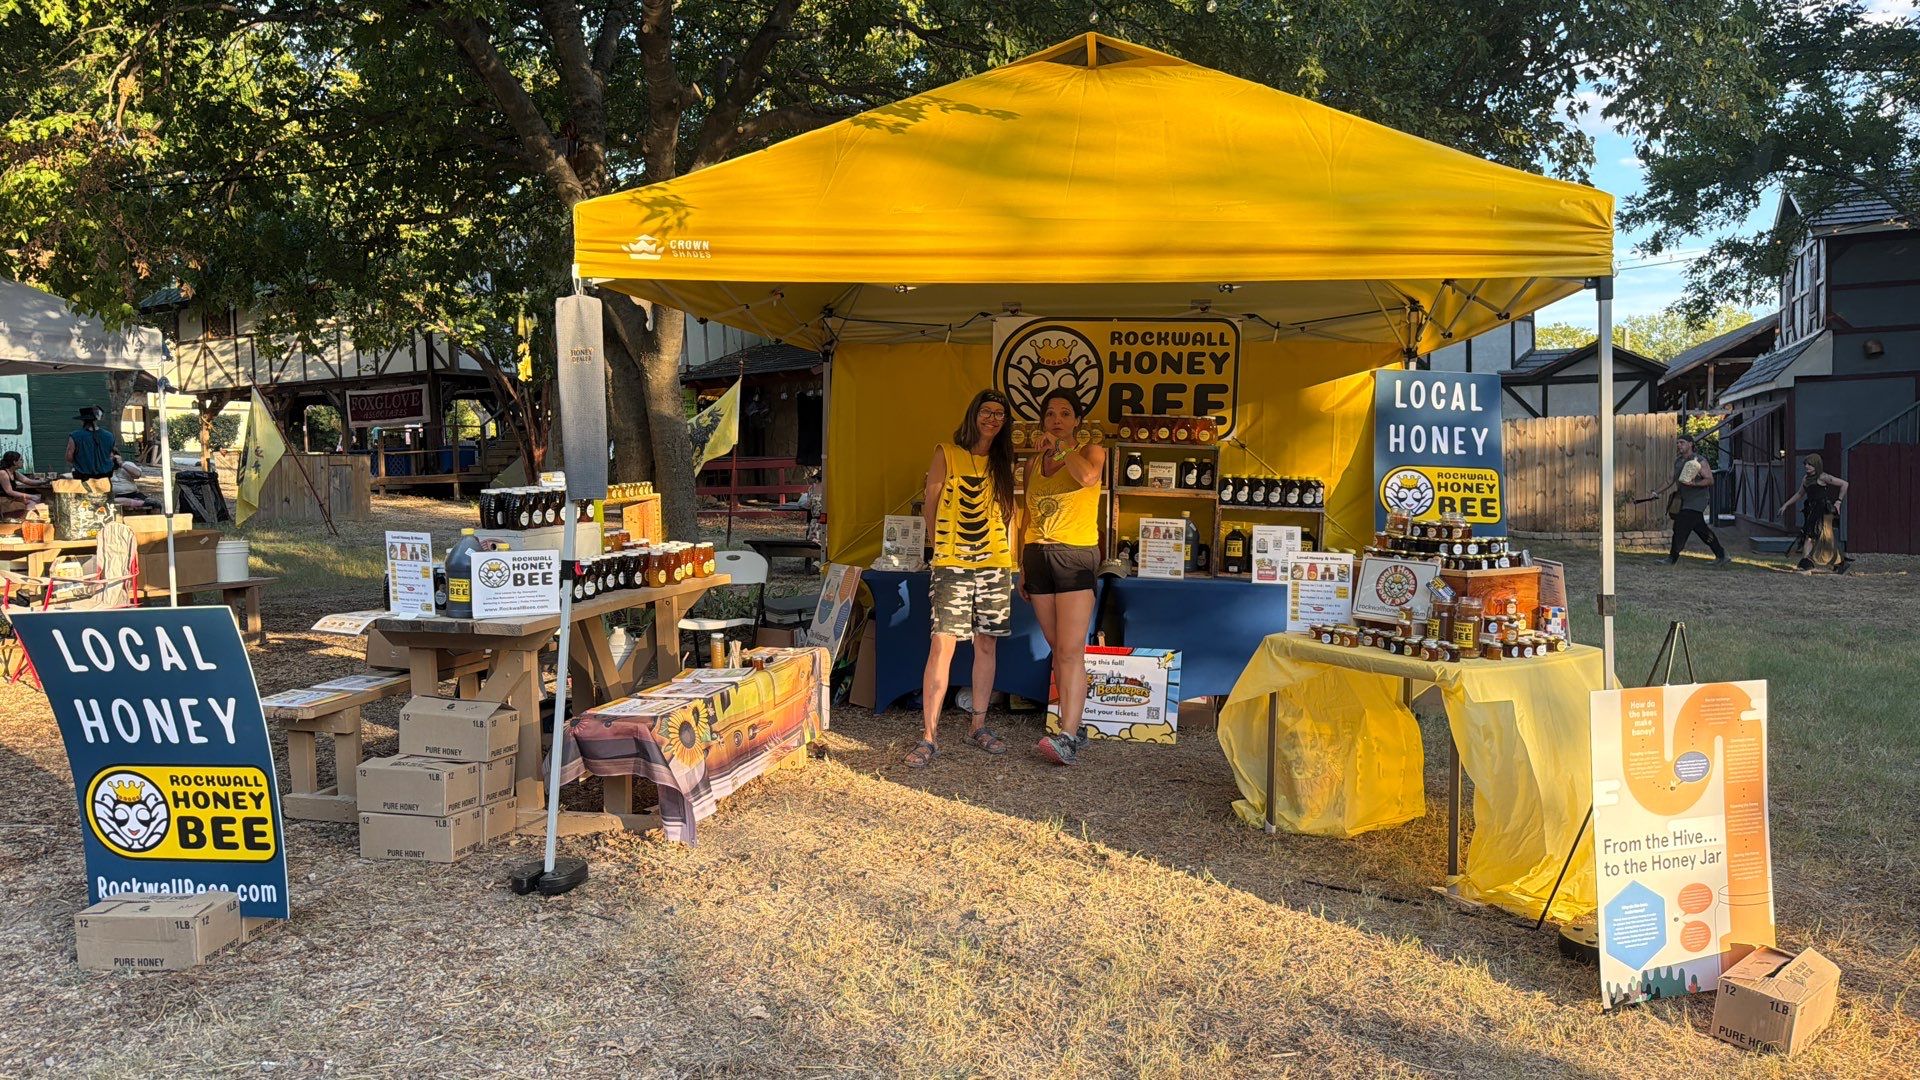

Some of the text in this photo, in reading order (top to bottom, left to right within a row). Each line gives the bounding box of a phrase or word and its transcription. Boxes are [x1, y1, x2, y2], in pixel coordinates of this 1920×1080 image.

[670, 240, 710, 250] CROWN
[672, 250, 712, 259] SHADES
[1110, 331, 1230, 346] ROCKWALL
[571, 348, 593, 356] HONEY
[1109, 351, 1230, 374] HONEY
[351, 392, 420, 411] FOXGLOVE
[1395, 380, 1483, 412] LOCAL
[1389, 424, 1488, 456] HONEY
[1437, 472, 1496, 482] ROCKWALL
[1437, 482, 1496, 494] HONEY
[1438, 496, 1498, 518] BEE
[512, 562, 552, 570] HONEY
[512, 572, 553, 586] BEE
[1376, 566, 1395, 604] Rockwall
[1397, 566, 1416, 591] Honey
[52, 626, 217, 672] LOCAL
[1096, 684, 1150, 698] Beekeepers
[1100, 694, 1142, 703] Conference
[1630, 701, 1645, 709] How
[74, 698, 236, 744] HONEY
[1629, 710, 1641, 718] the
[425, 746, 462, 756] PURE HONEY
[491, 744, 517, 757] PURE HONEY
[170, 775, 263, 787] ROCKWALL
[172, 791, 265, 810] HONEY
[486, 792, 498, 801] PURE
[400, 803, 419, 812] HONEY
[448, 797, 476, 811] PURE HONEY
[435, 820, 450, 828] 1LB.
[176, 815, 271, 851] BEE
[1604, 829, 1717, 854] From the Hive...
[404, 850, 425, 859] HONEY
[1604, 862, 1620, 877] to
[1624, 858, 1648, 874] the
[1651, 854, 1696, 871] Honey
[1700, 850, 1722, 865] Jar
[202, 901, 240, 926] 12 1LB.
[79, 919, 194, 930] 12 1LB.
[248, 924, 262, 939] PURE
[205, 938, 240, 964] PURE HONEY
[114, 958, 164, 967] PURE HONEY
[1724, 984, 1736, 996] 12
[1769, 1001, 1792, 1017] 1LB.
[1719, 1025, 1746, 1044] PURE
